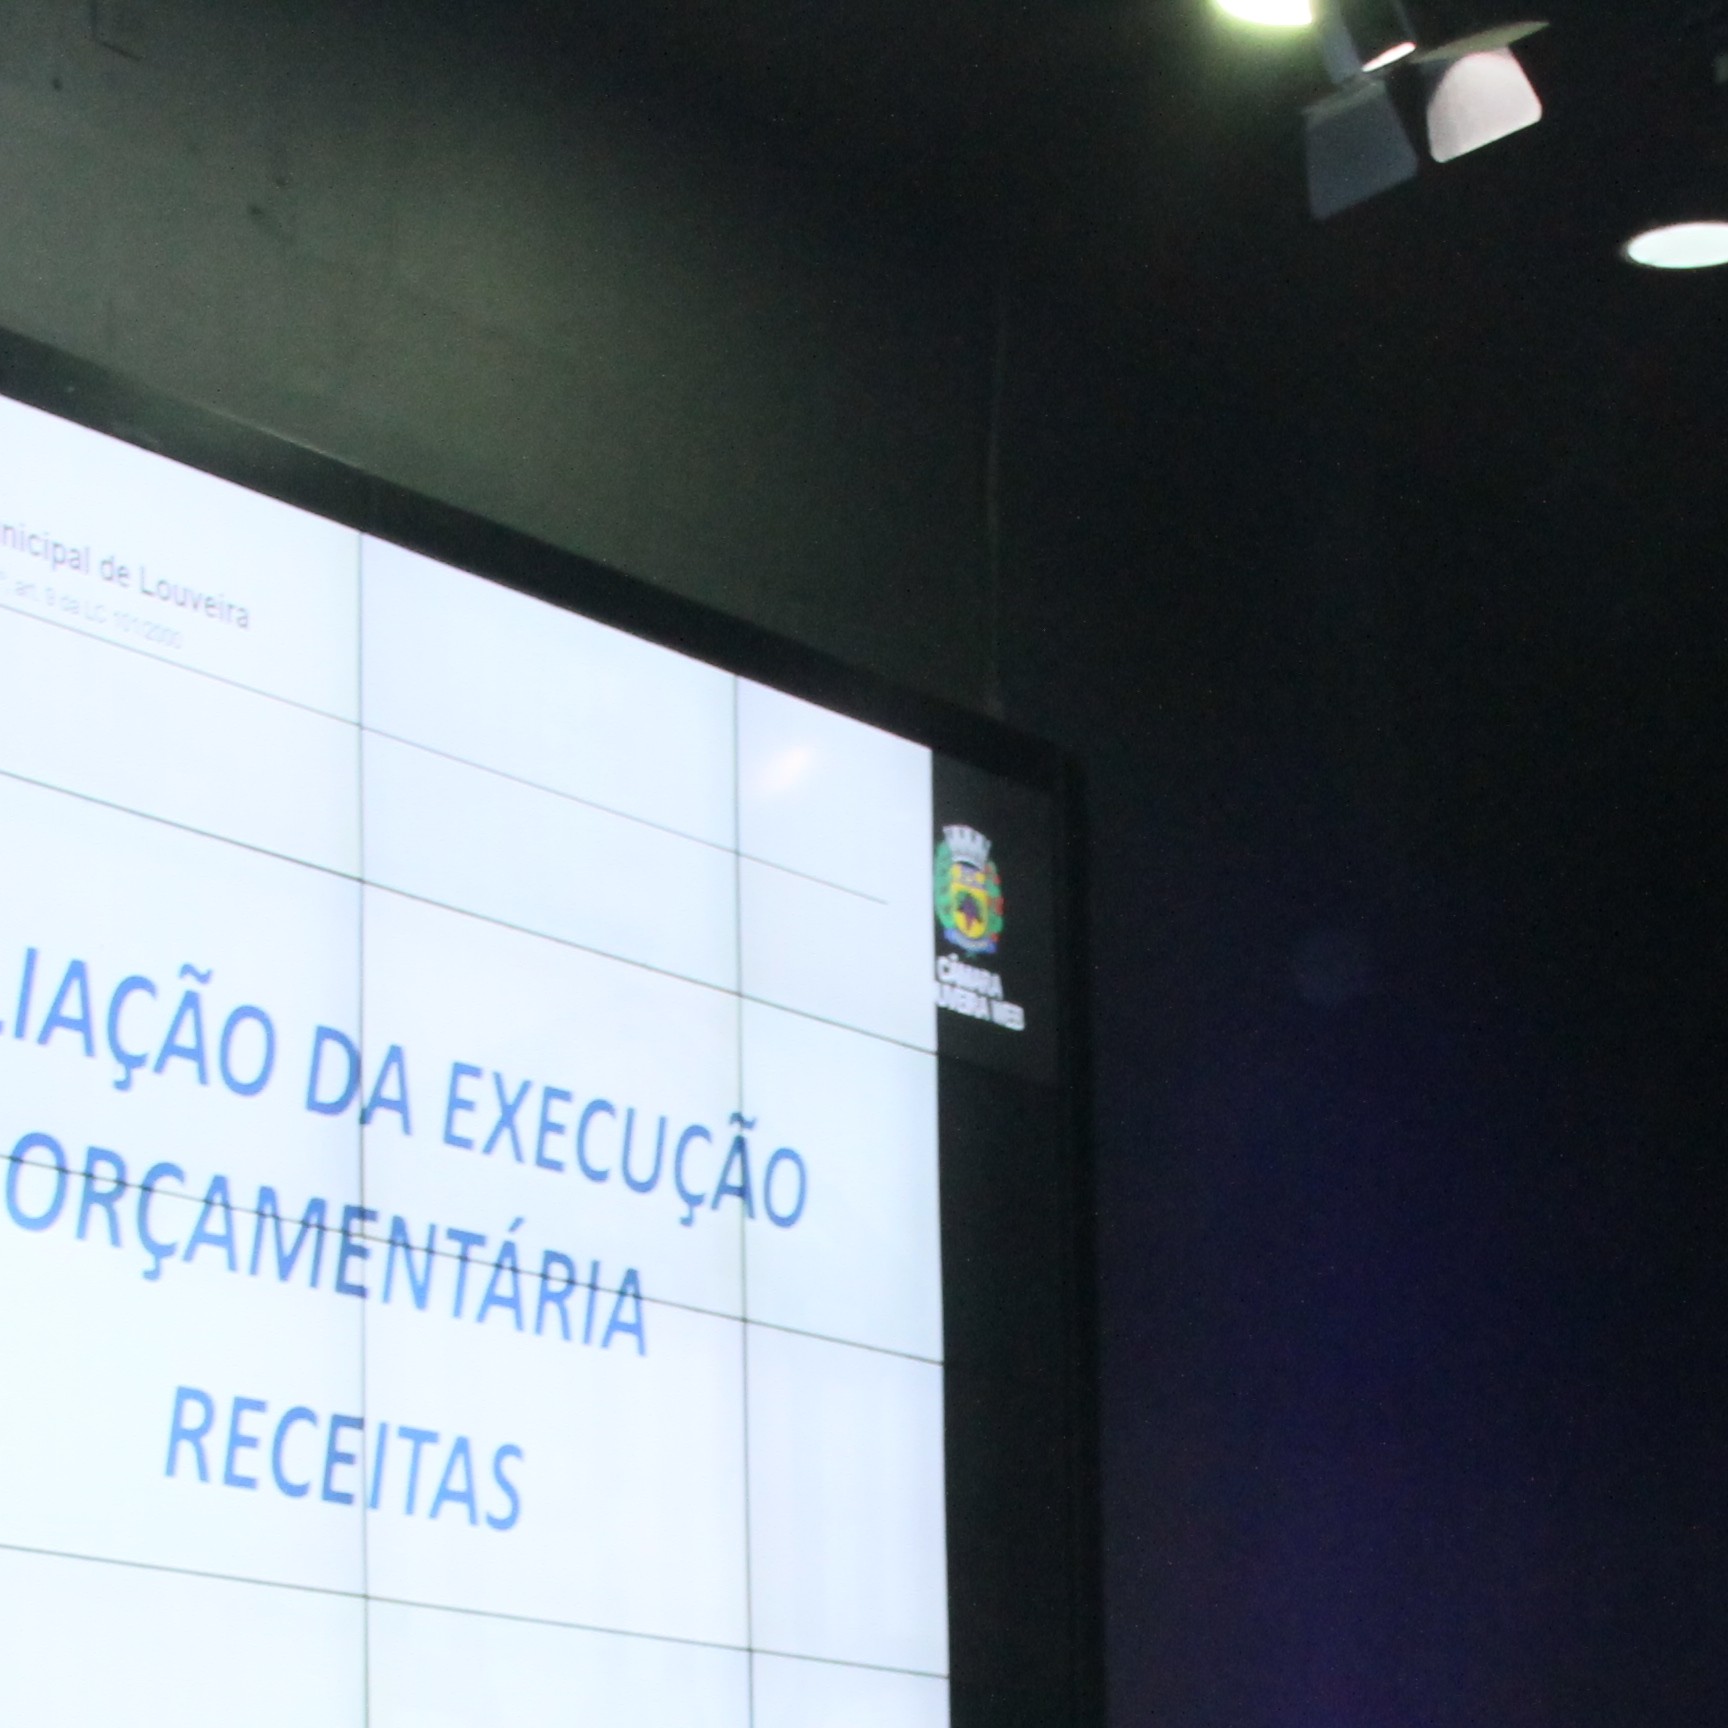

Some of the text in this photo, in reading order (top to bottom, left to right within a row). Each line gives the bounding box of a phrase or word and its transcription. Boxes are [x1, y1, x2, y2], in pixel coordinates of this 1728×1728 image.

[100, 550, 129, 588] de
[140, 561, 251, 631] Louveira
[306, 1025, 414, 1136] DA
[440, 1060, 809, 1231] EXECUÇÃO
[5, 1131, 650, 1358] ORÇAMENTÁRIA
[164, 1385, 526, 1532] RECEITAS
